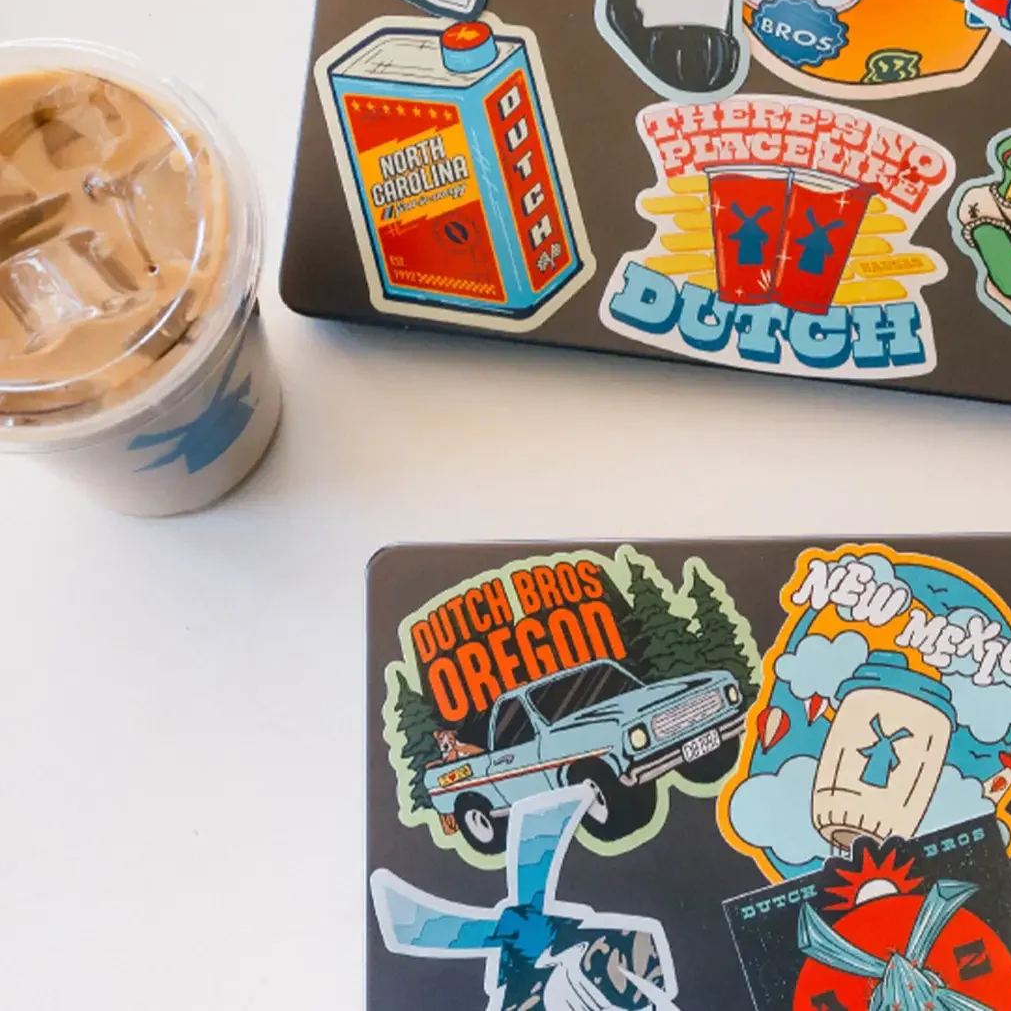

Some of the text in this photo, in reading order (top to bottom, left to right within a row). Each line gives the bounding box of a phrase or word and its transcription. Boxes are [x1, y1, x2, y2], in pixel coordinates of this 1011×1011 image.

[760, 17, 833, 52] BROS
[371, 156, 469, 208] CAROLINA
[379, 135, 446, 179] NORTH
[498, 84, 553, 250] DUTCH
[643, 101, 947, 187] THERE'S NO
[655, 132, 929, 213] PLACE LIKE
[609, 261, 926, 369] DUTCH
[411, 559, 604, 663] DUTCH BROS
[791, 559, 910, 626] NEW
[428, 601, 627, 722] OREGON
[740, 827, 986, 920] DUTCH BROS
